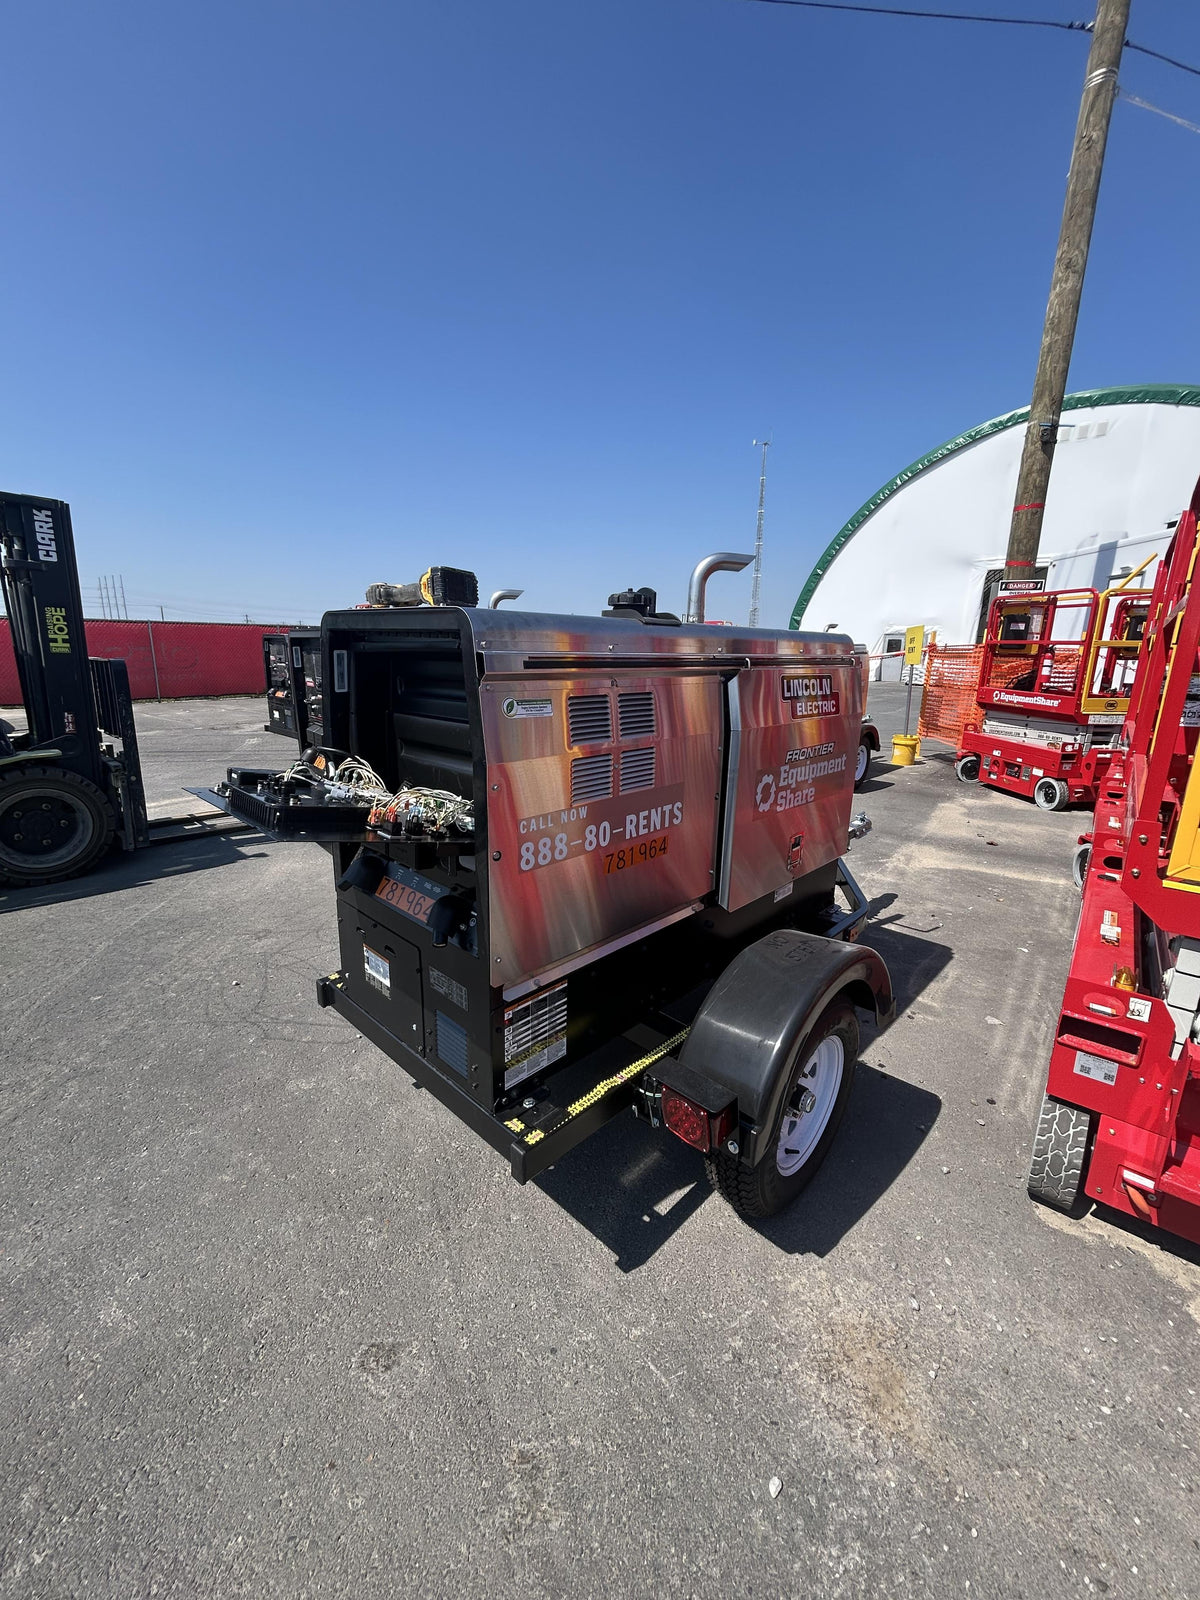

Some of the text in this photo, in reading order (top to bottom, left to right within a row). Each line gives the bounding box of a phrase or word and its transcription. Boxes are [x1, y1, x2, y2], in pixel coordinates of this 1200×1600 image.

[32, 509, 58, 562] CLARK
[45, 606, 55, 634] RAISING
[49, 607, 71, 648] HOPE
[783, 678, 831, 697] LINCOLN
[1000, 692, 1060, 707] EquipmentShare
[795, 699, 837, 716] ELECTRIC
[785, 742, 836, 763] FRONTIER
[778, 753, 848, 791] Equipment
[776, 787, 815, 813] Share
[519, 806, 588, 834] CALL NOW
[519, 801, 683, 871] 888-80-RENTS
[605, 837, 668, 874] 781964
